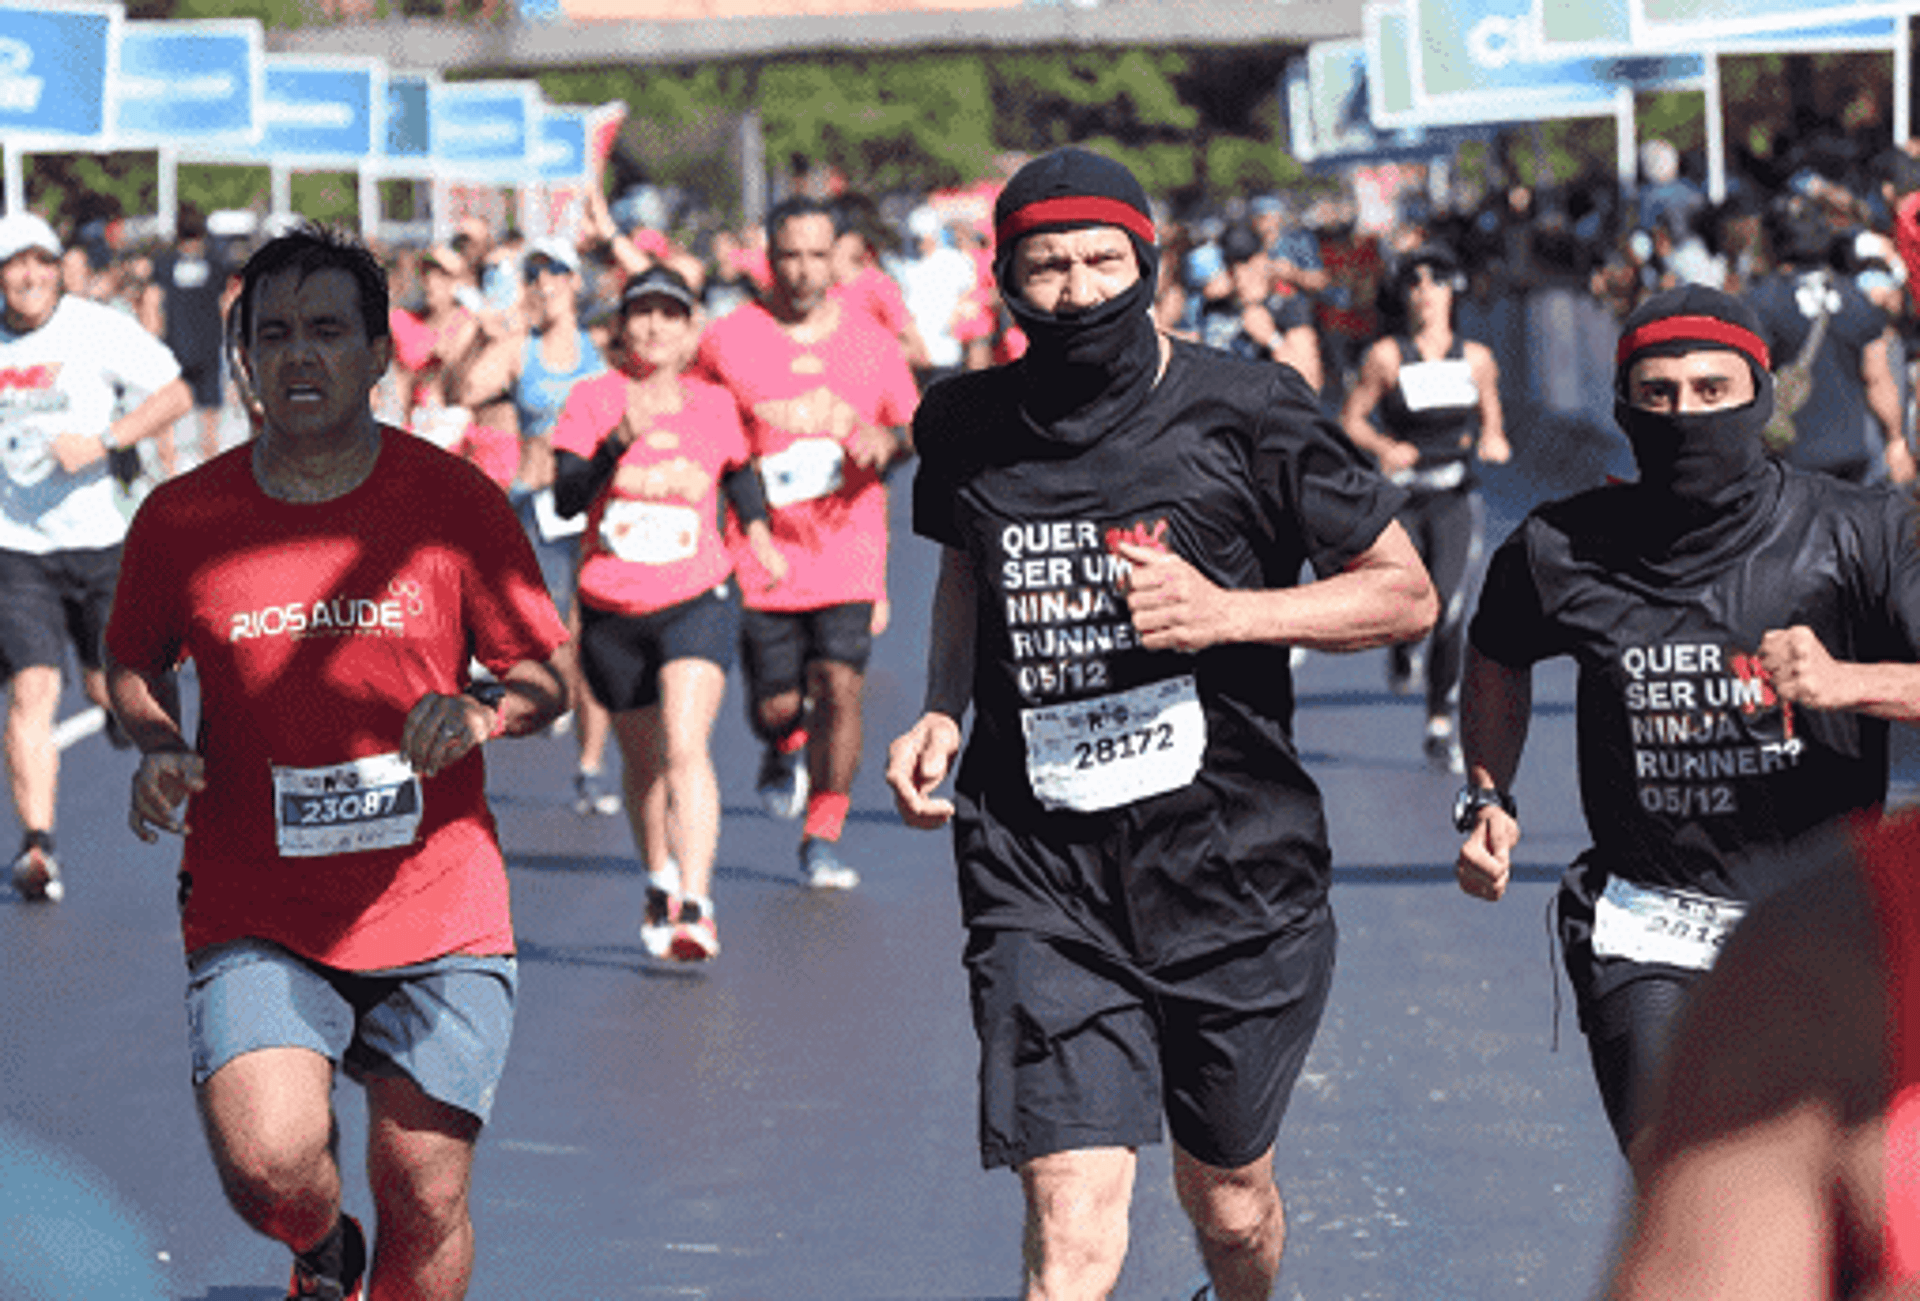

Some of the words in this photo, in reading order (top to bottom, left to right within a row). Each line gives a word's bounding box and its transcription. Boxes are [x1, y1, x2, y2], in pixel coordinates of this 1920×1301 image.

[1002, 521, 1099, 557] QUER
[1003, 557, 1073, 589] SER
[1084, 554, 1132, 583] UM
[1007, 589, 1116, 623] NINJA
[1011, 624, 1142, 657] RUNNE
[1020, 661, 1107, 692] 05/12
[1621, 643, 1722, 679] QUER
[1625, 681, 1697, 710] SER
[1703, 677, 1763, 706] UM
[1631, 712, 1741, 744] NINJA
[1074, 722, 1175, 770] 28172
[1636, 738, 1804, 778] RUNNER?
[301, 787, 398, 824] 23087
[1639, 785, 1737, 816] 05/12
